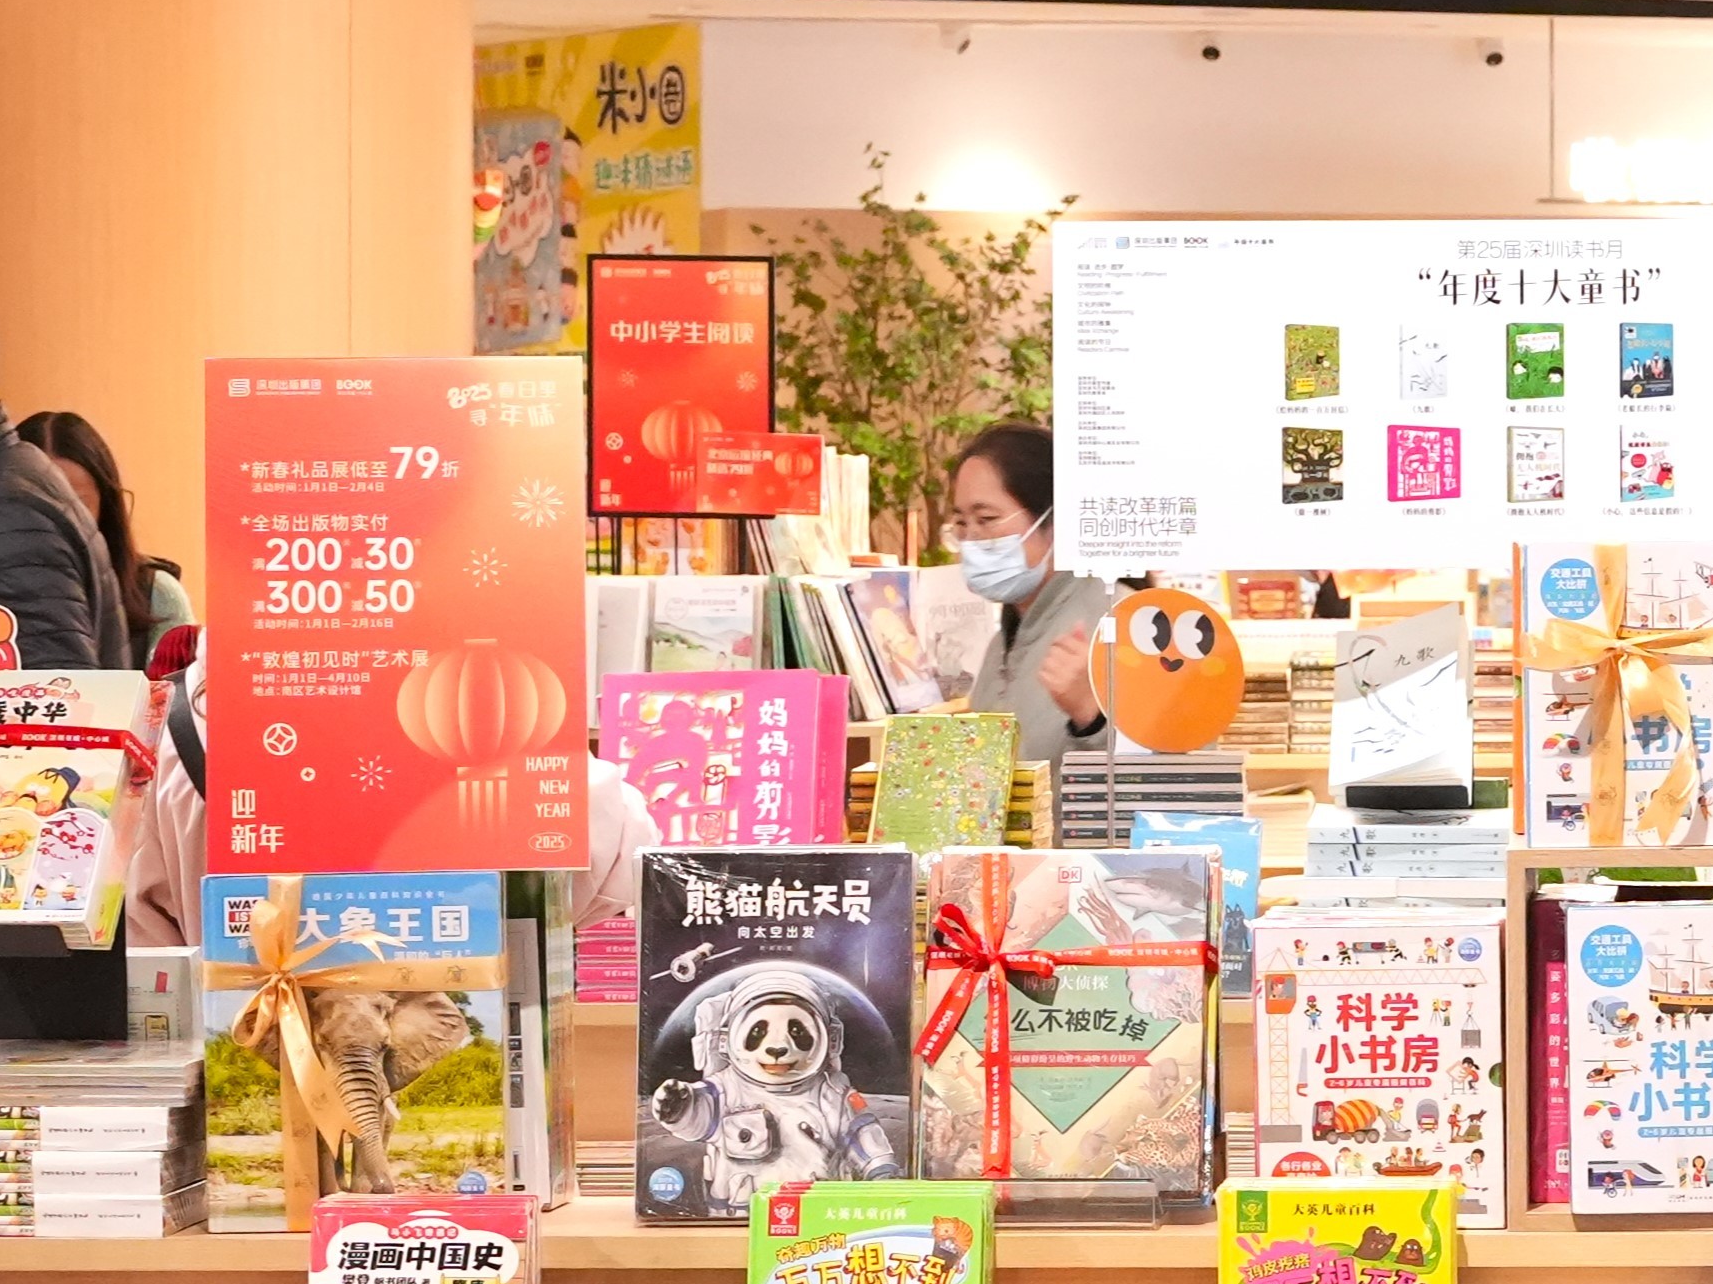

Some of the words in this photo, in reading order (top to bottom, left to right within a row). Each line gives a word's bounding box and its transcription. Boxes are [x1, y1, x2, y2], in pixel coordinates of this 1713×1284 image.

[1079, 497, 1197, 516] 共读改革新篇
[1079, 517, 1198, 537] 同创时代华章
[525, 756, 569, 772] HAPPY
[539, 780, 569, 795] NEW
[535, 803, 570, 818] YEAR
[230, 824, 285, 854] 新年
[683, 878, 872, 927] 熊猫航天员
[737, 925, 817, 939] 向太空出发
[1335, 992, 1419, 1033] 科学
[1313, 1035, 1441, 1076] 小书房
[1292, 1202, 1375, 1217] 大英儿童百科
[337, 1241, 505, 1272] 漫画中国史
